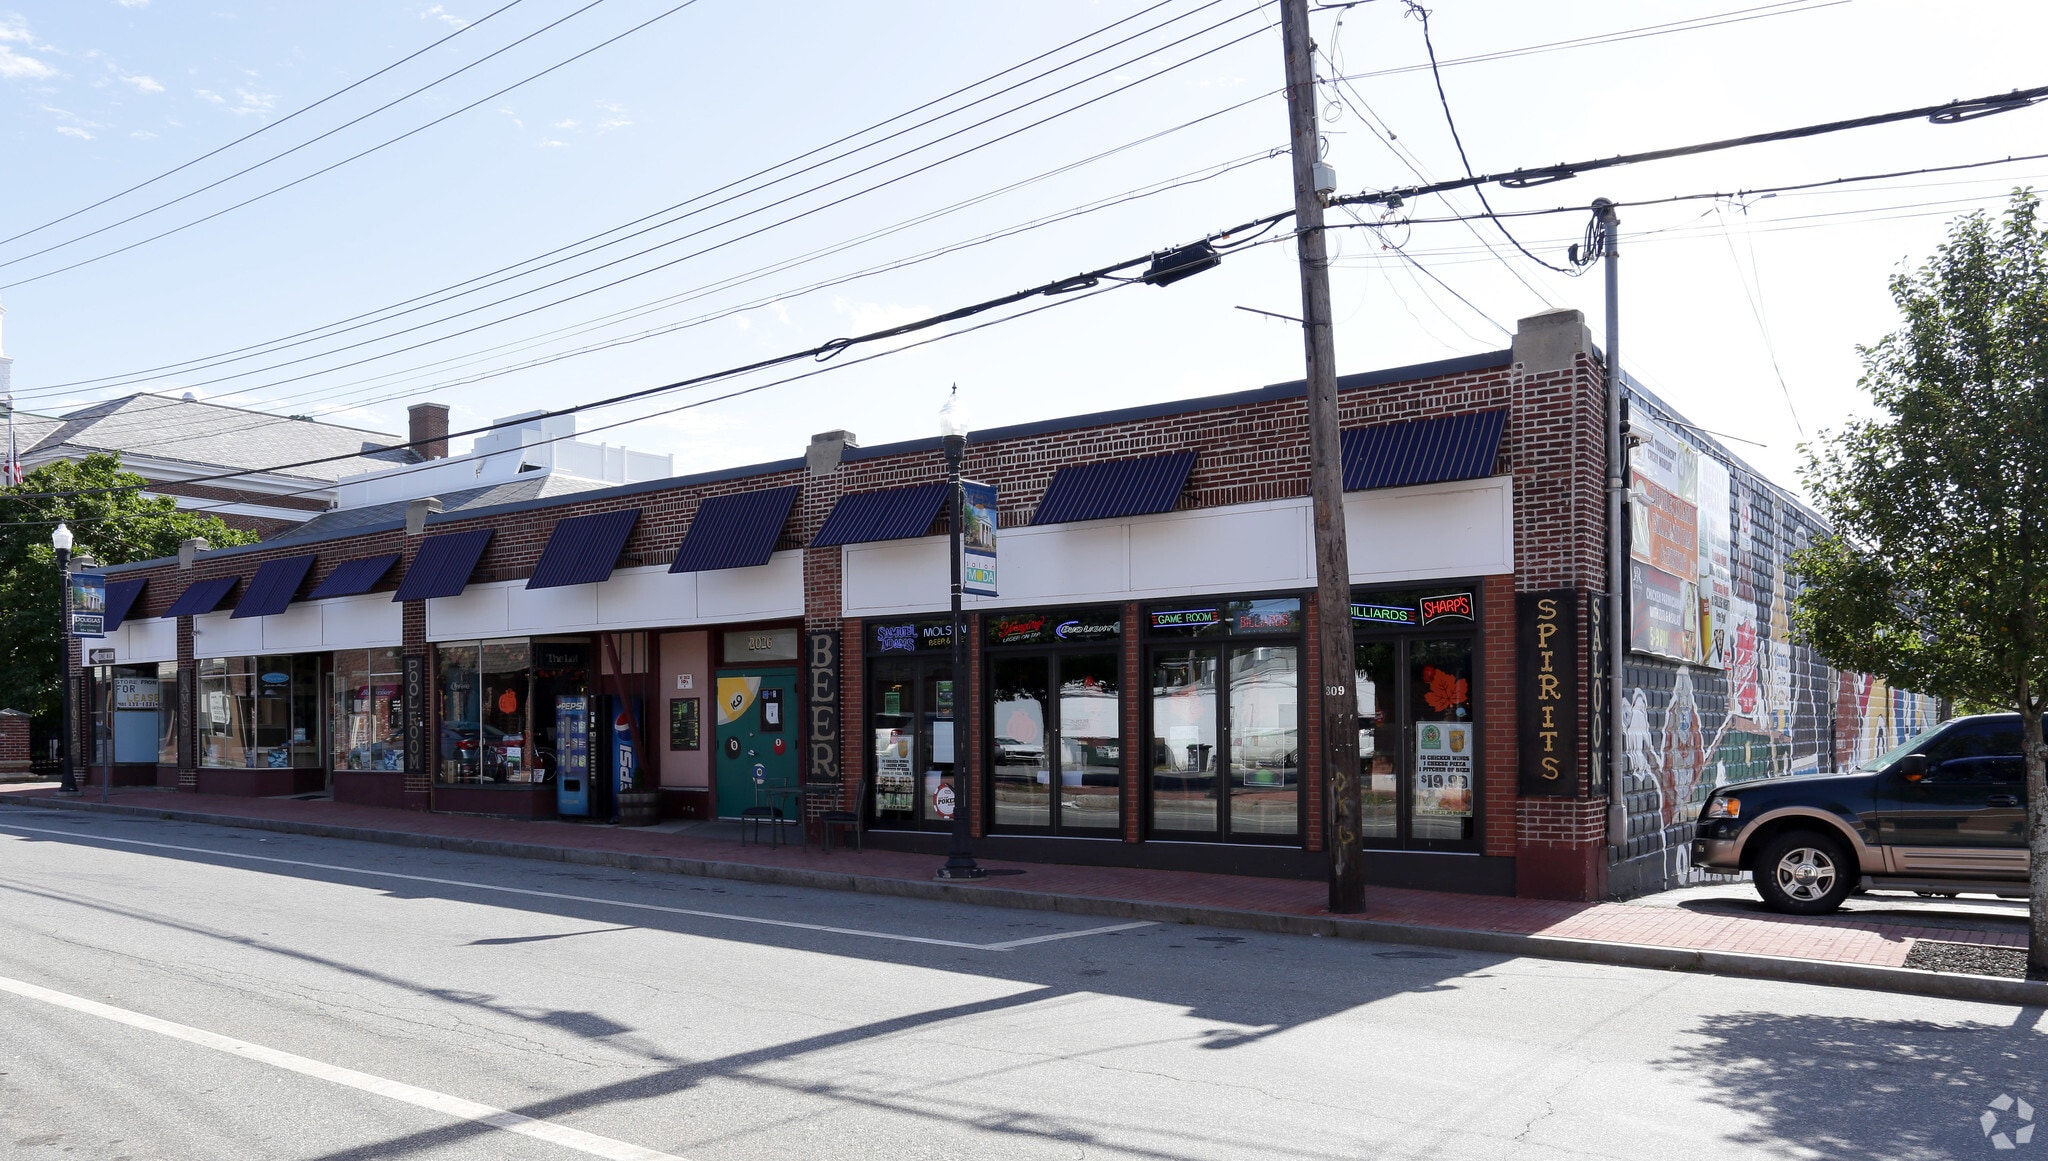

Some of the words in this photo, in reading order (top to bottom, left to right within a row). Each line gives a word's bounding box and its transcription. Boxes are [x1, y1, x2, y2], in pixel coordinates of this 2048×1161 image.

[1423, 596, 1470, 618] SHARP'S
[75, 616, 101, 624] DOUGLAS
[1157, 613, 1183, 625] GAME
[1185, 611, 1212, 622] ROOM
[923, 624, 968, 638] MOLSN
[748, 637, 773, 651] 2026
[116, 685, 136, 693] FOR
[1325, 685, 1345, 696] 309
[1537, 598, 1562, 781] SPIRITS
[1592, 597, 1603, 786] SALOON
[560, 702, 586, 710] PEPSI
[810, 633, 839, 778] BEER
